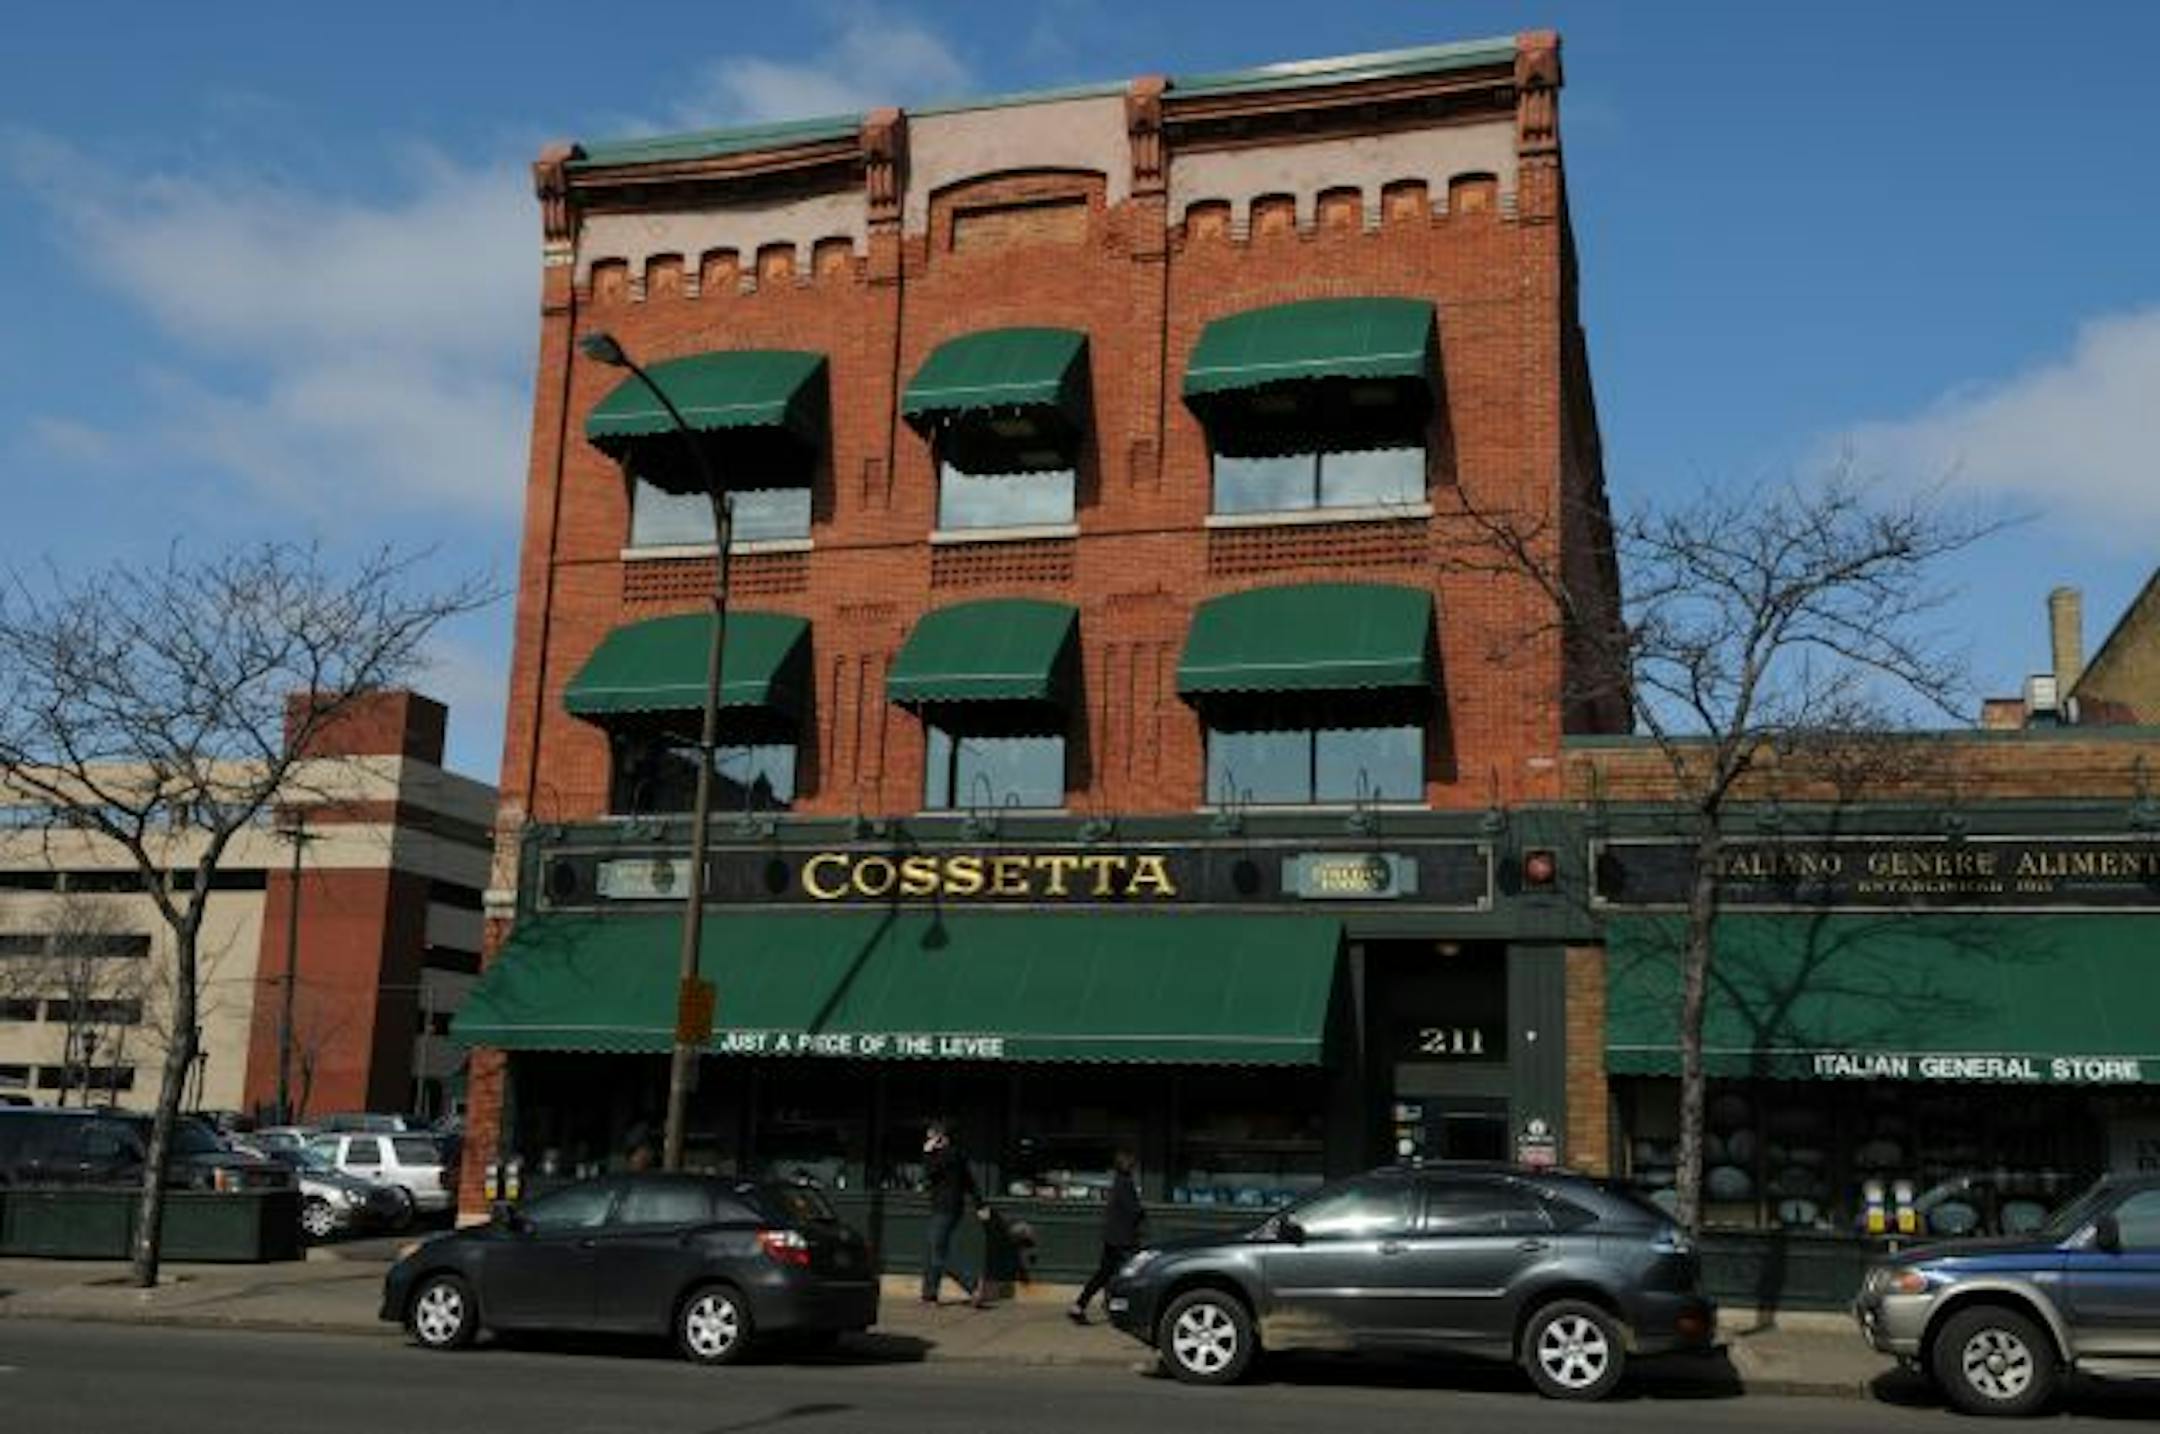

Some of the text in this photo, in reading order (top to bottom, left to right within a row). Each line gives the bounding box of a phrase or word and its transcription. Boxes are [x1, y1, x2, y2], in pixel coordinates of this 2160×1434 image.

[801, 852, 1176, 900] COSSETTA
[1867, 851, 1997, 876] GENERE
[721, 1033, 764, 1051] JUST
[776, 1034, 791, 1051] A
[860, 1034, 886, 1054] OF
[896, 1035, 933, 1055] THE
[940, 1037, 1004, 1057] LEVEE
[1419, 1027, 1484, 1054] 211
[1814, 1054, 2142, 1081] ITALIAN GENERAL STORE
